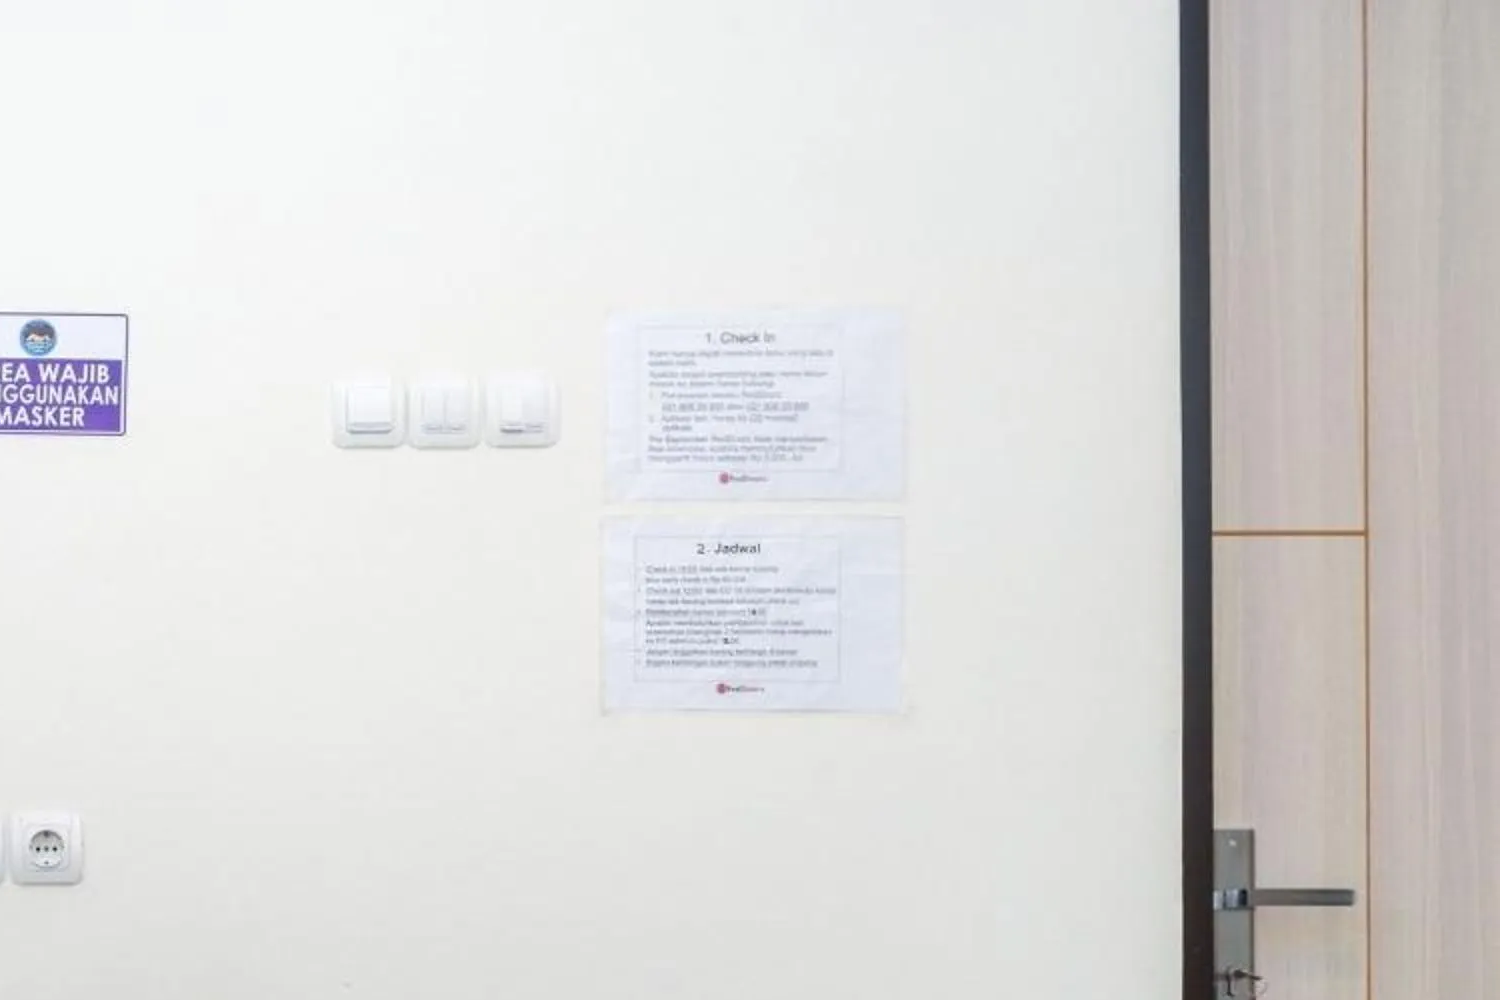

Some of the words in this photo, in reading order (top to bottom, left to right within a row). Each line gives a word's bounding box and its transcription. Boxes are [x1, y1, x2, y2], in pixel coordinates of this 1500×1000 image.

[719, 331, 761, 345] Check
[37, 362, 110, 384] WAJIB
[714, 543, 761, 556] Jadwal
